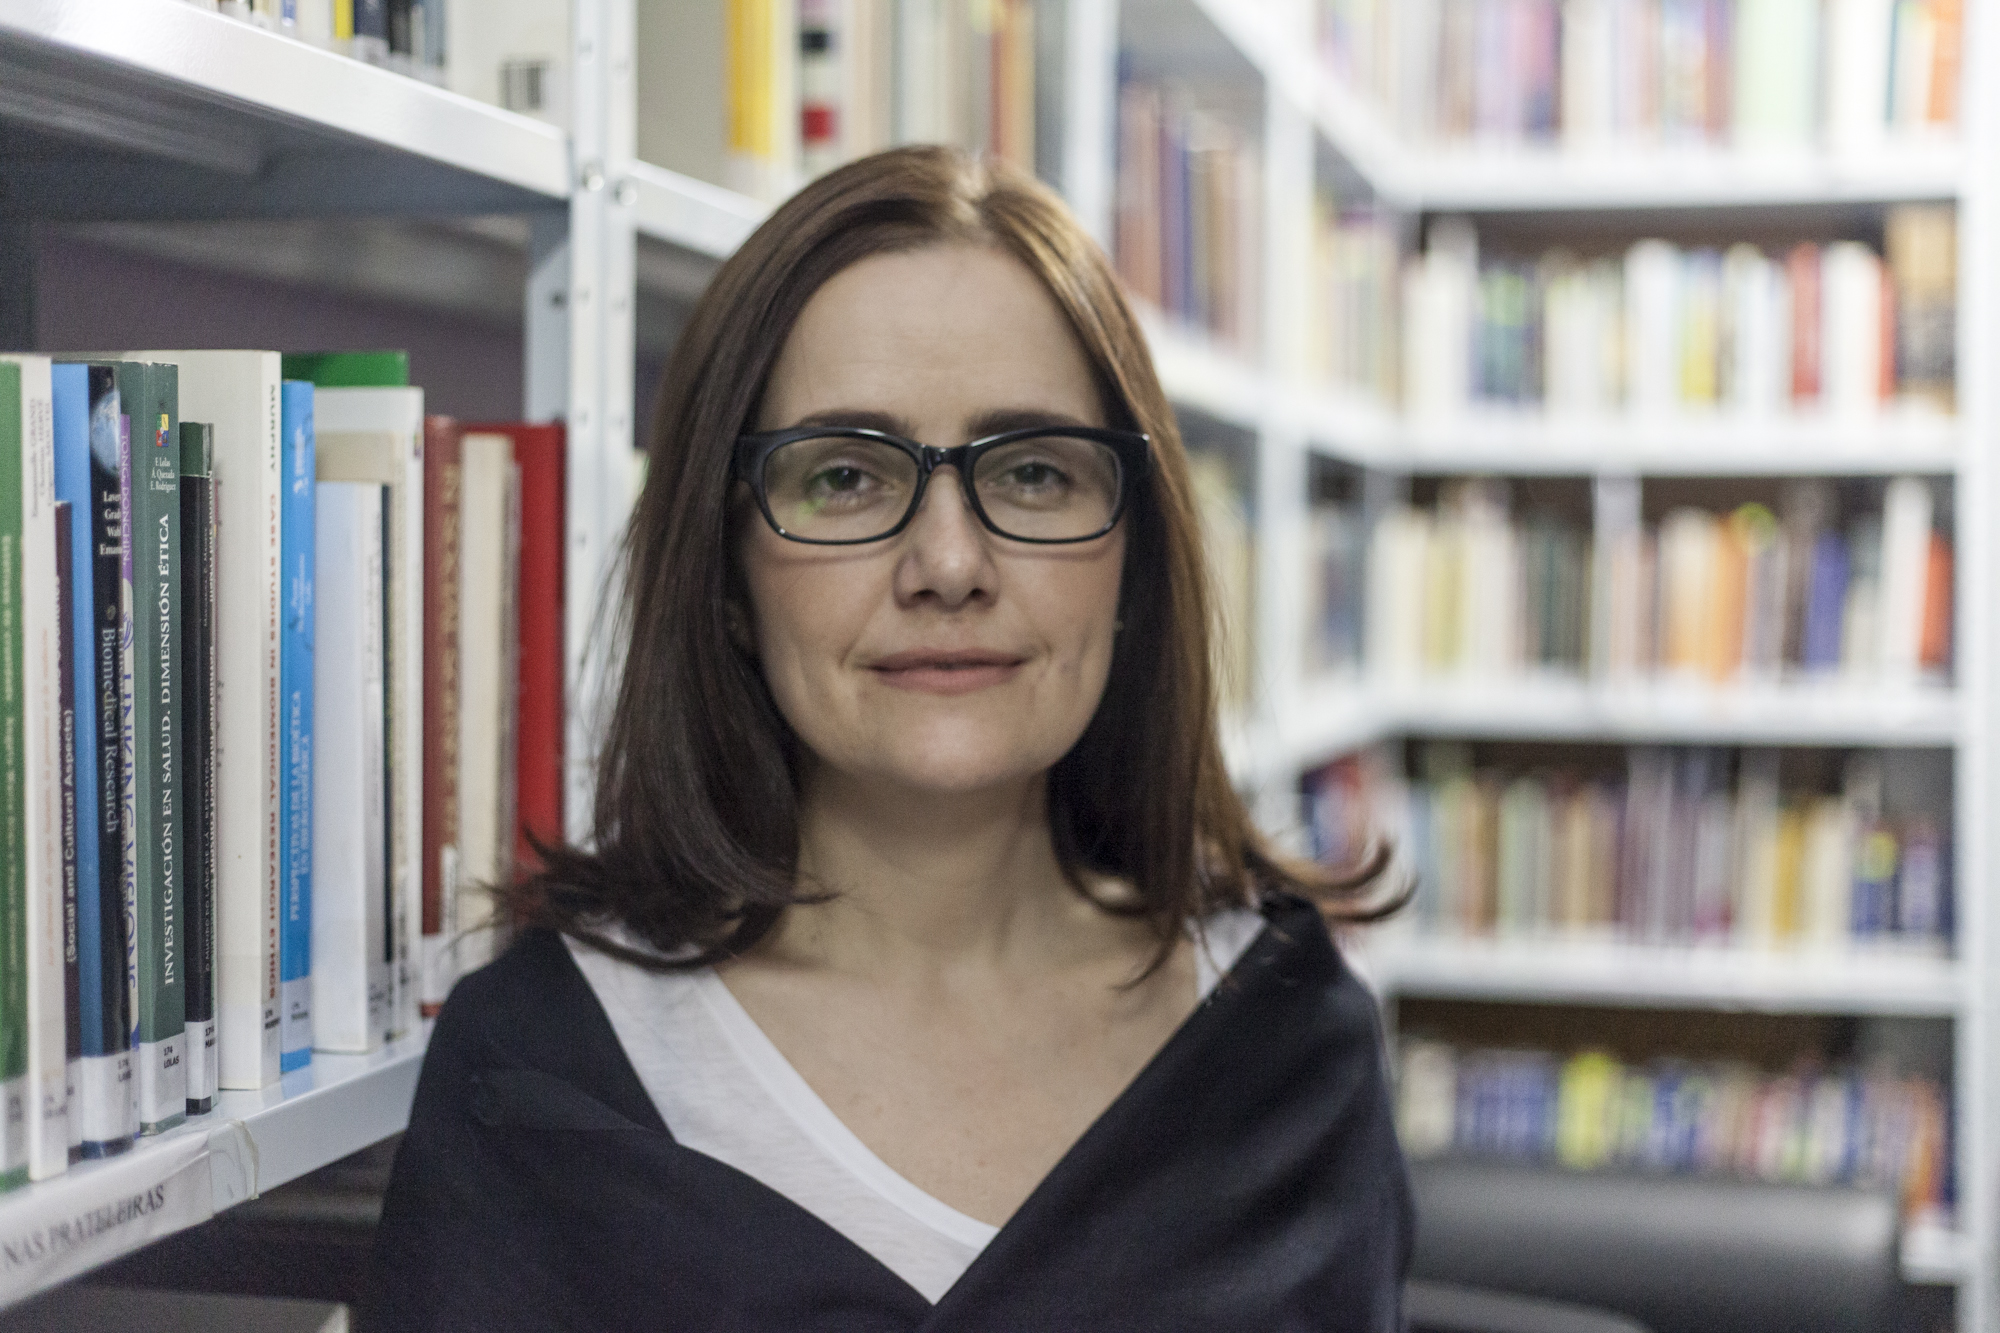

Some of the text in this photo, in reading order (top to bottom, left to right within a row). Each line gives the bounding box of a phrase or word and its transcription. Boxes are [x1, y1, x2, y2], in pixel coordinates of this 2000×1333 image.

[101, 628, 119, 833] Biomedical Research
[157, 513, 174, 985] INVESTIGACIÓN EN SALUD. DIMENSIÓN ÉTICA
[63, 709, 78, 963] (Social and Cultural Aspects)
[163, 1055, 180, 1069] LOLAS
[164, 1045, 173, 1057] 174
